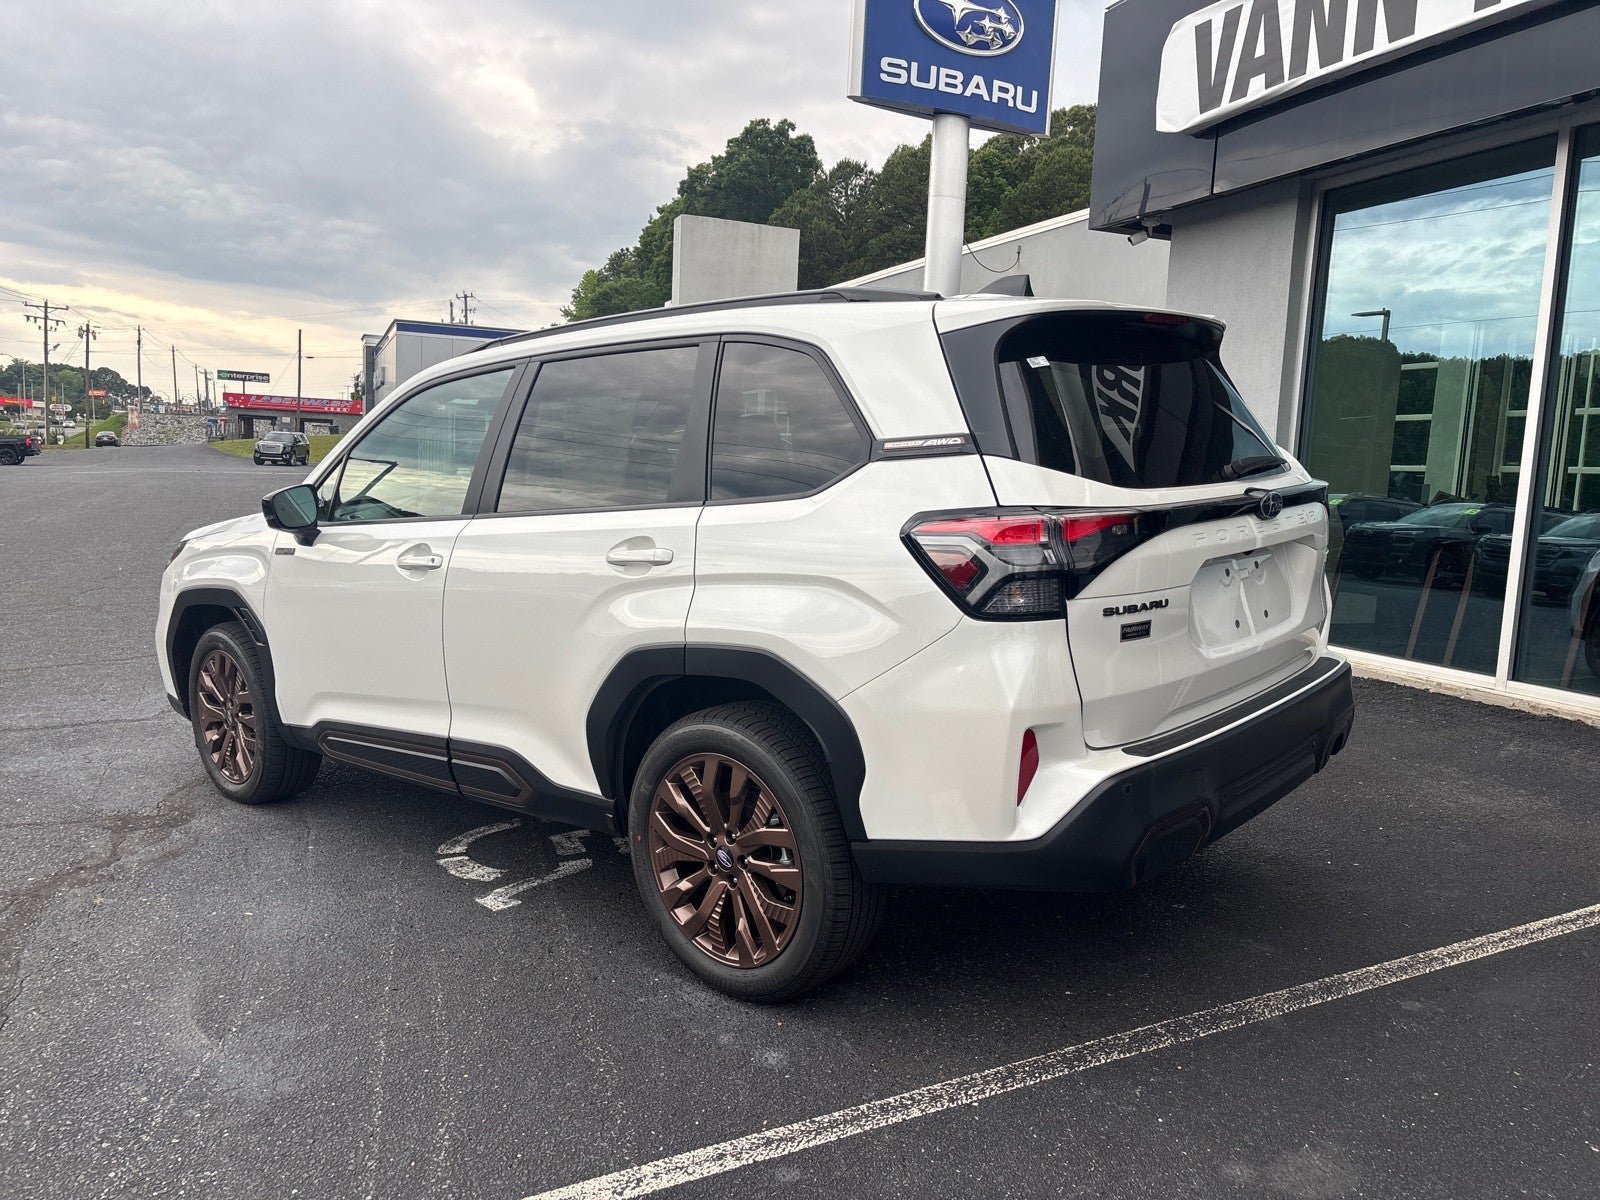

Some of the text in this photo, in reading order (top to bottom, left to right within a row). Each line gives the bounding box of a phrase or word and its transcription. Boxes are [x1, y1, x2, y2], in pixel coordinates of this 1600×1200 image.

[879, 56, 1039, 114] SUBARU
[219, 372, 269, 380] enterprise
[923, 436, 962, 447] AWD
[1102, 598, 1169, 617] SUBARU
